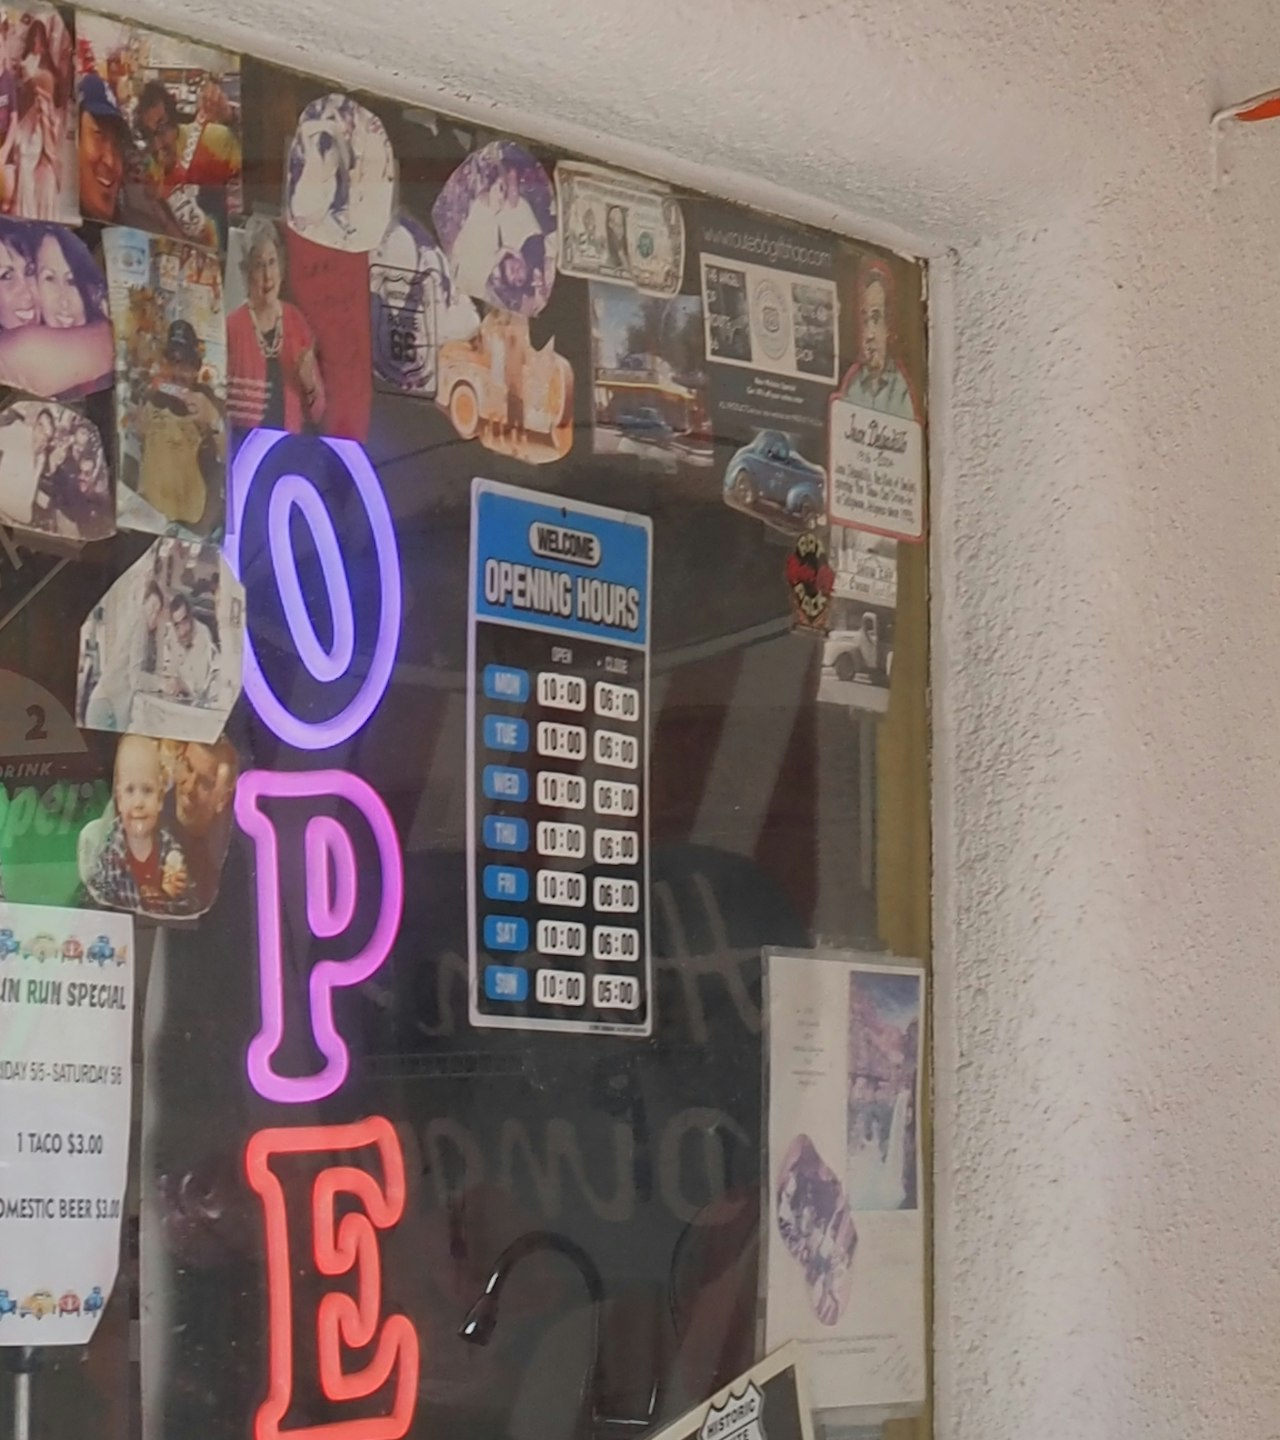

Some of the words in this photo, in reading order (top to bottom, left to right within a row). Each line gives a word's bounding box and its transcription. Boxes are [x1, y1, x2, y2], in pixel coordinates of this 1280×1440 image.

[537, 526, 595, 561] WELCOME
[484, 558, 573, 617] OPENING
[576, 576, 640, 630] HOURS
[551, 646, 573, 664] OPEN
[494, 672, 522, 696] MON
[543, 677, 582, 706] 10:00
[25, 705, 49, 741] 2
[495, 721, 519, 747] TUE
[543, 727, 582, 755] 10:00
[542, 776, 582, 804] 10:00
[494, 822, 518, 846] THU
[542, 826, 582, 853] 10:00
[496, 872, 517, 895] FRI
[542, 875, 582, 902] 10:00
[495, 921, 518, 945] SAT
[542, 925, 582, 951] 10:00
[27, 978, 62, 1006] RUN
[66, 981, 127, 1010] SPECIAL
[494, 972, 518, 996] SUN
[542, 974, 581, 1001] 10:00
[16, 1132, 24, 1154] 1
[29, 1132, 62, 1155] TACO
[66, 1133, 103, 1156] $3.00
[59, 1198, 93, 1220] BEER
[95, 1198, 121, 1220] $3.00
[706, 1399, 757, 1440] HISTORIC
